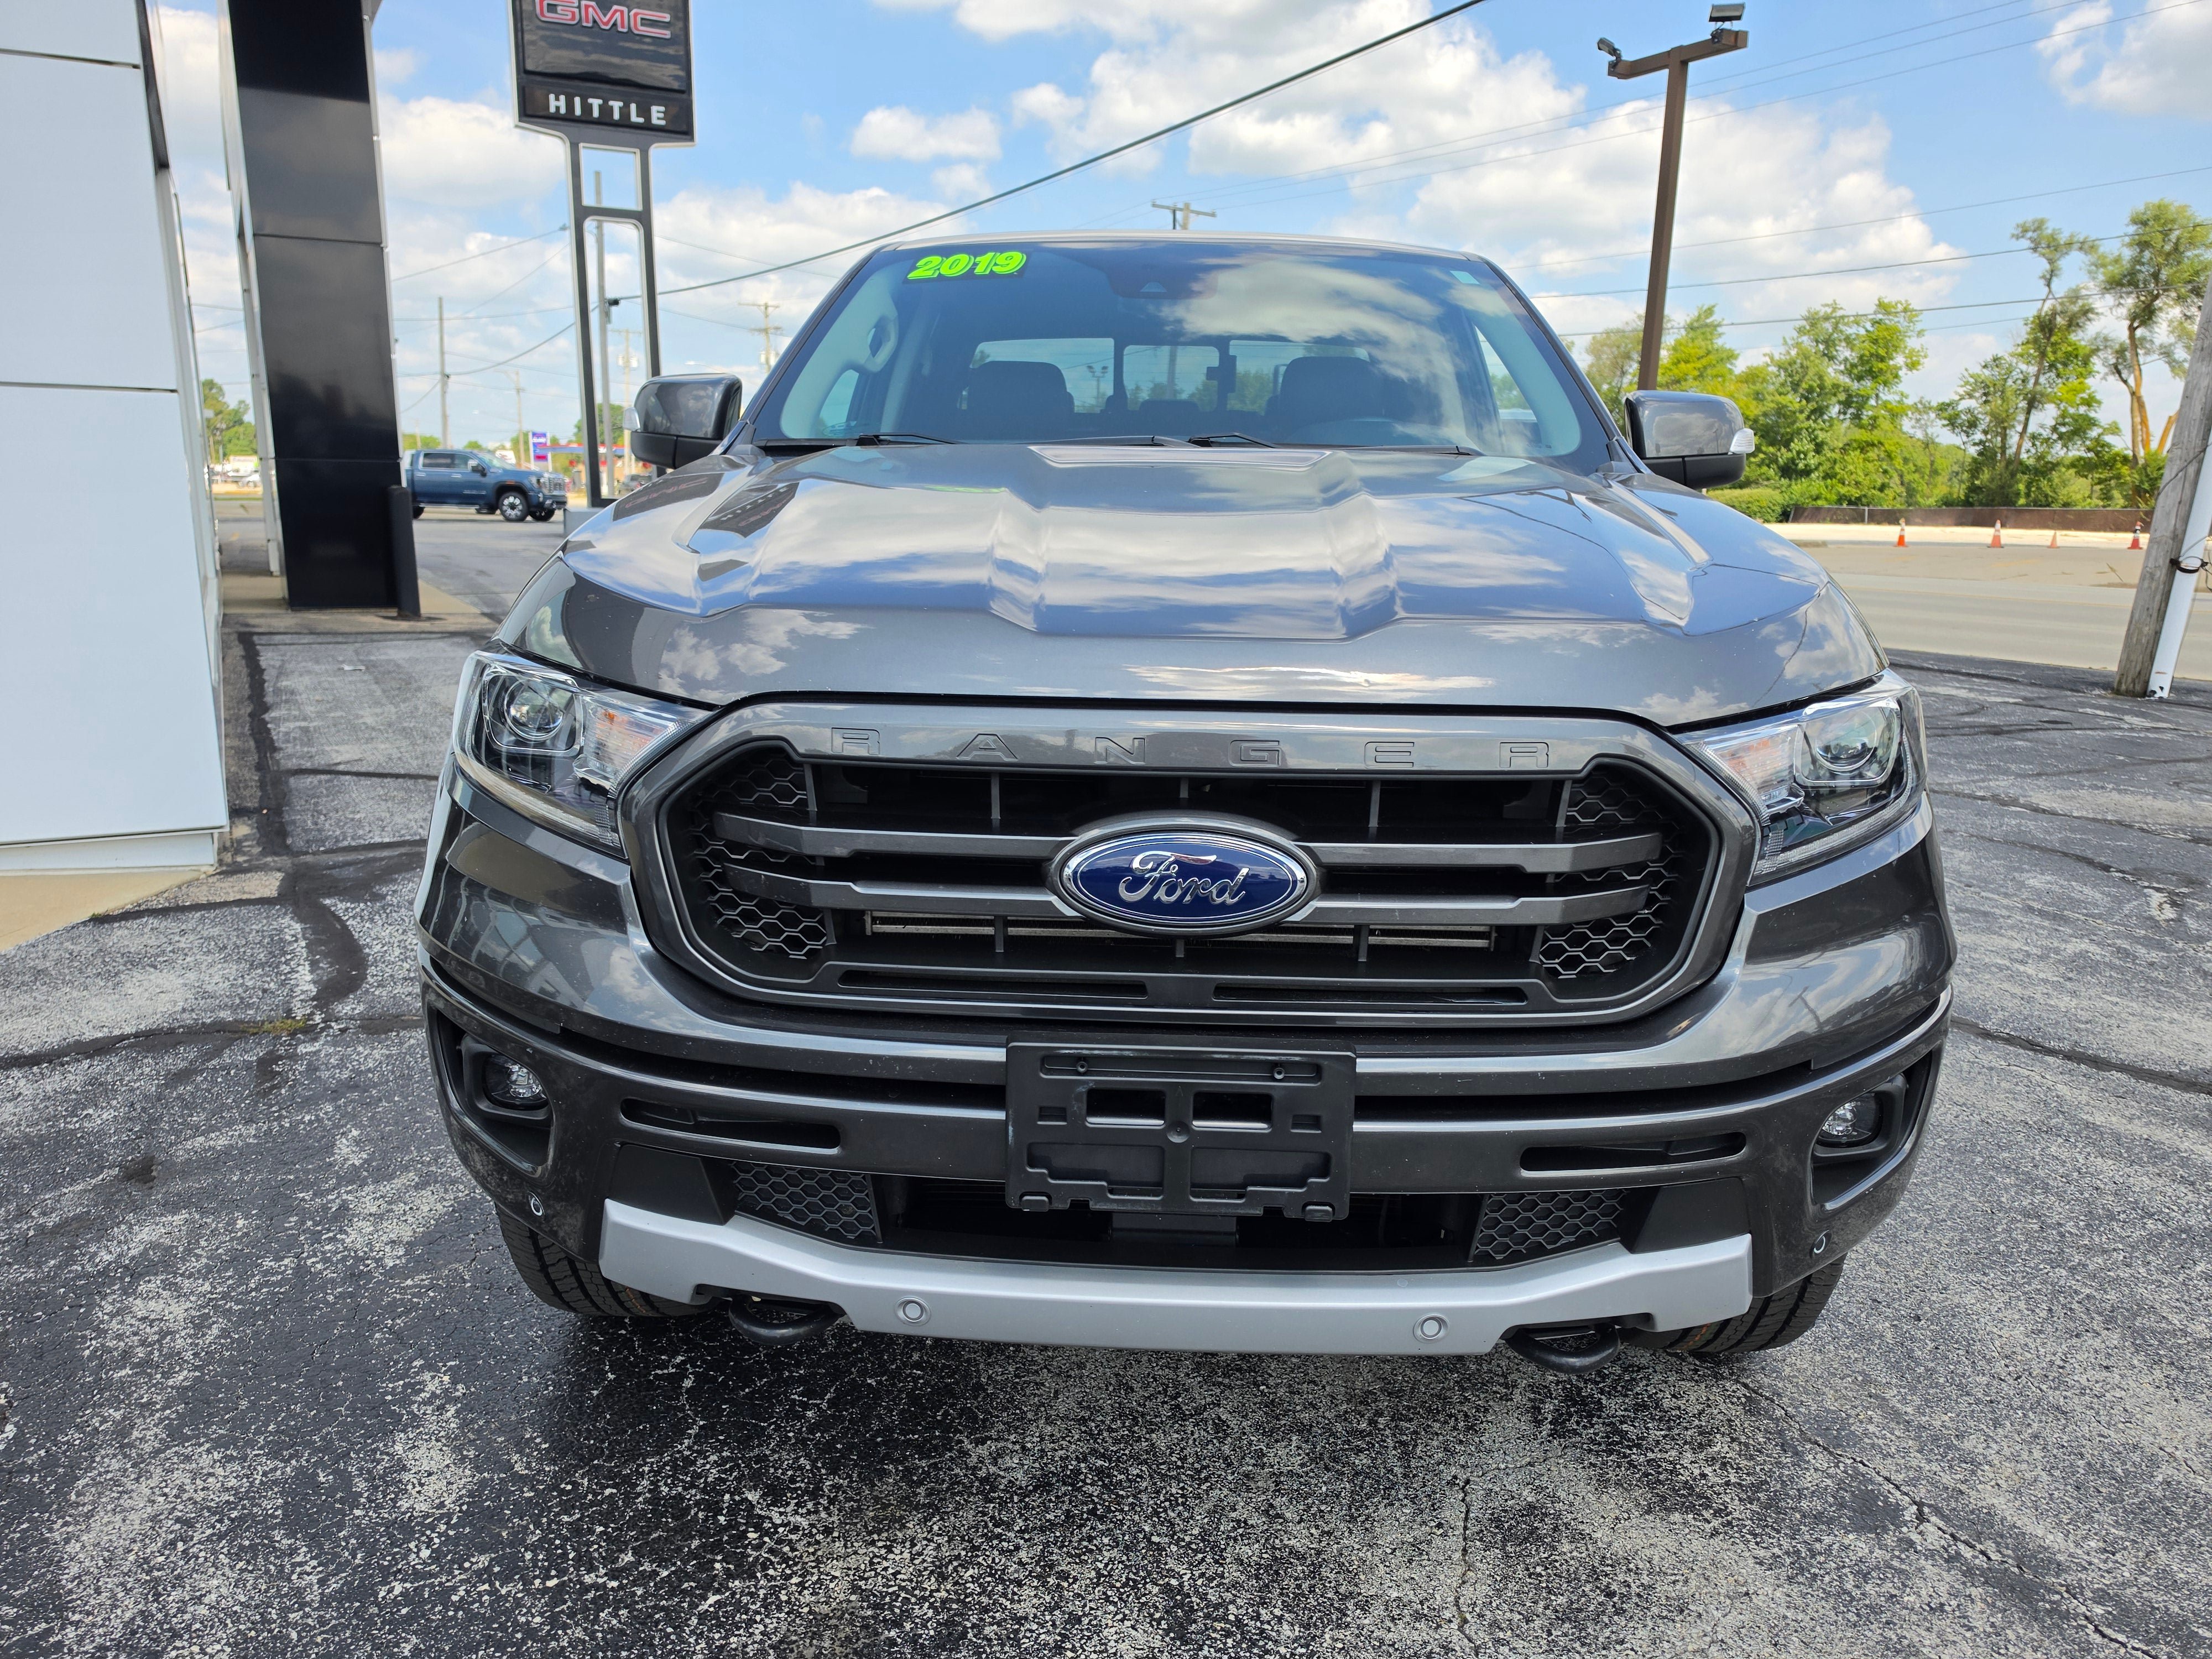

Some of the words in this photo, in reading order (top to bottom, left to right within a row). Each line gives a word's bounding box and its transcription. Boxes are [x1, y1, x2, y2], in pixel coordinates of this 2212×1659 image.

[535, 0, 671, 39] GMC
[548, 93, 666, 126] HITTLE
[907, 251, 1027, 280] 2019
[831, 727, 1549, 768] RANGER
[1118, 851, 1250, 905] Ford
